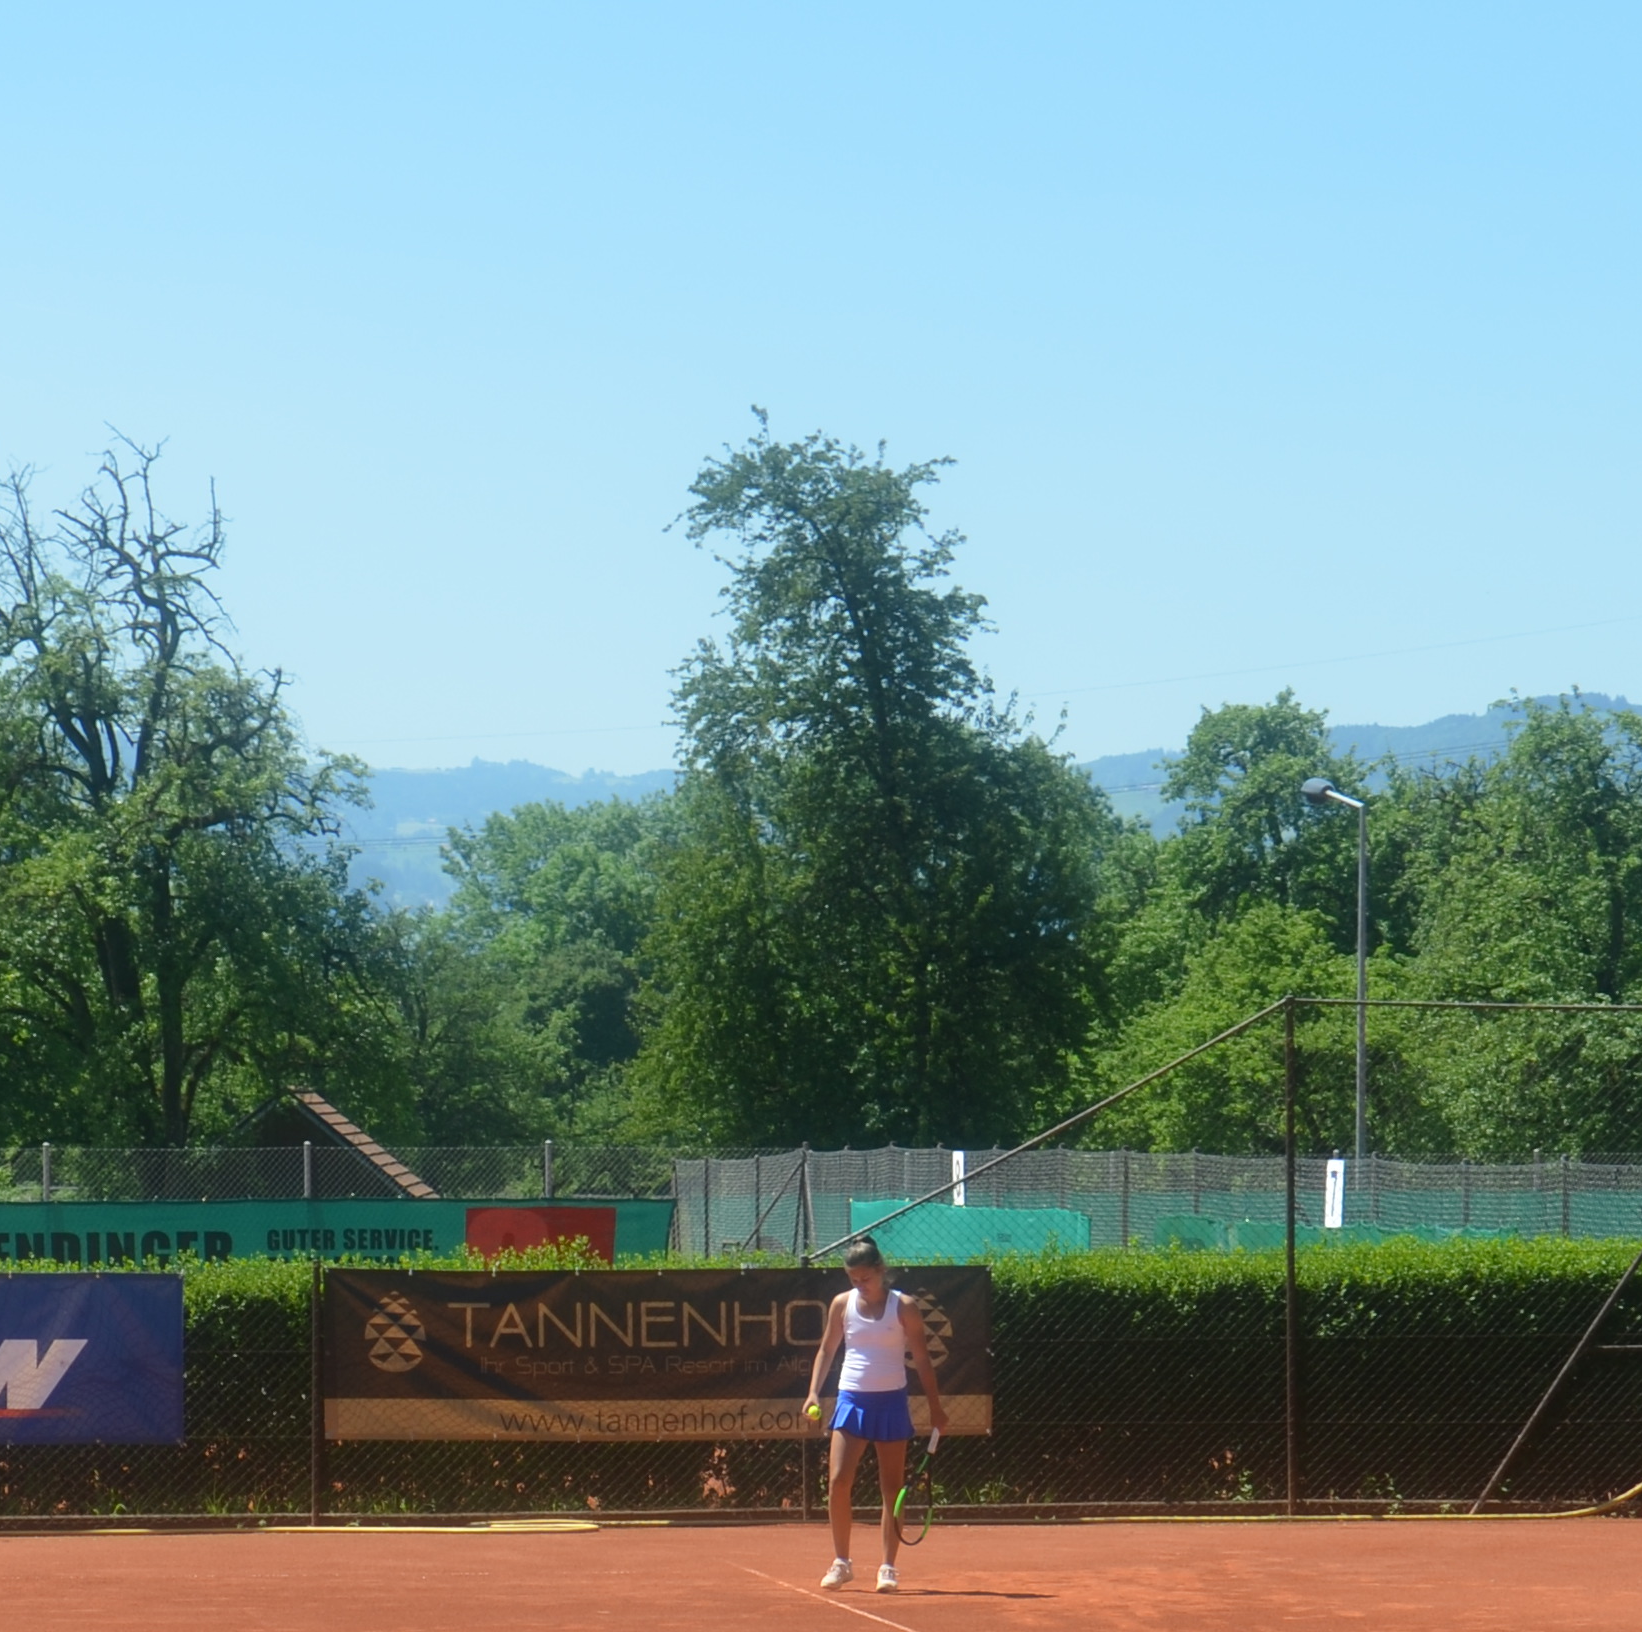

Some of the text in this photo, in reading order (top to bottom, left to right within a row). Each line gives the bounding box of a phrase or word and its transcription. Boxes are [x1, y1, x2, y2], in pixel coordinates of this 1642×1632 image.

[267, 1228, 440, 1251] GUTER SERVICE.
[447, 1300, 828, 1348] TANNENHO
[480, 1356, 504, 1374] Ihr
[516, 1355, 574, 1377] Sport
[584, 1357, 599, 1374] &
[608, 1355, 656, 1374] SPA
[666, 1355, 735, 1374] Resort
[744, 1356, 767, 1373] im
[500, 1405, 823, 1433] www.tannenhof.com
